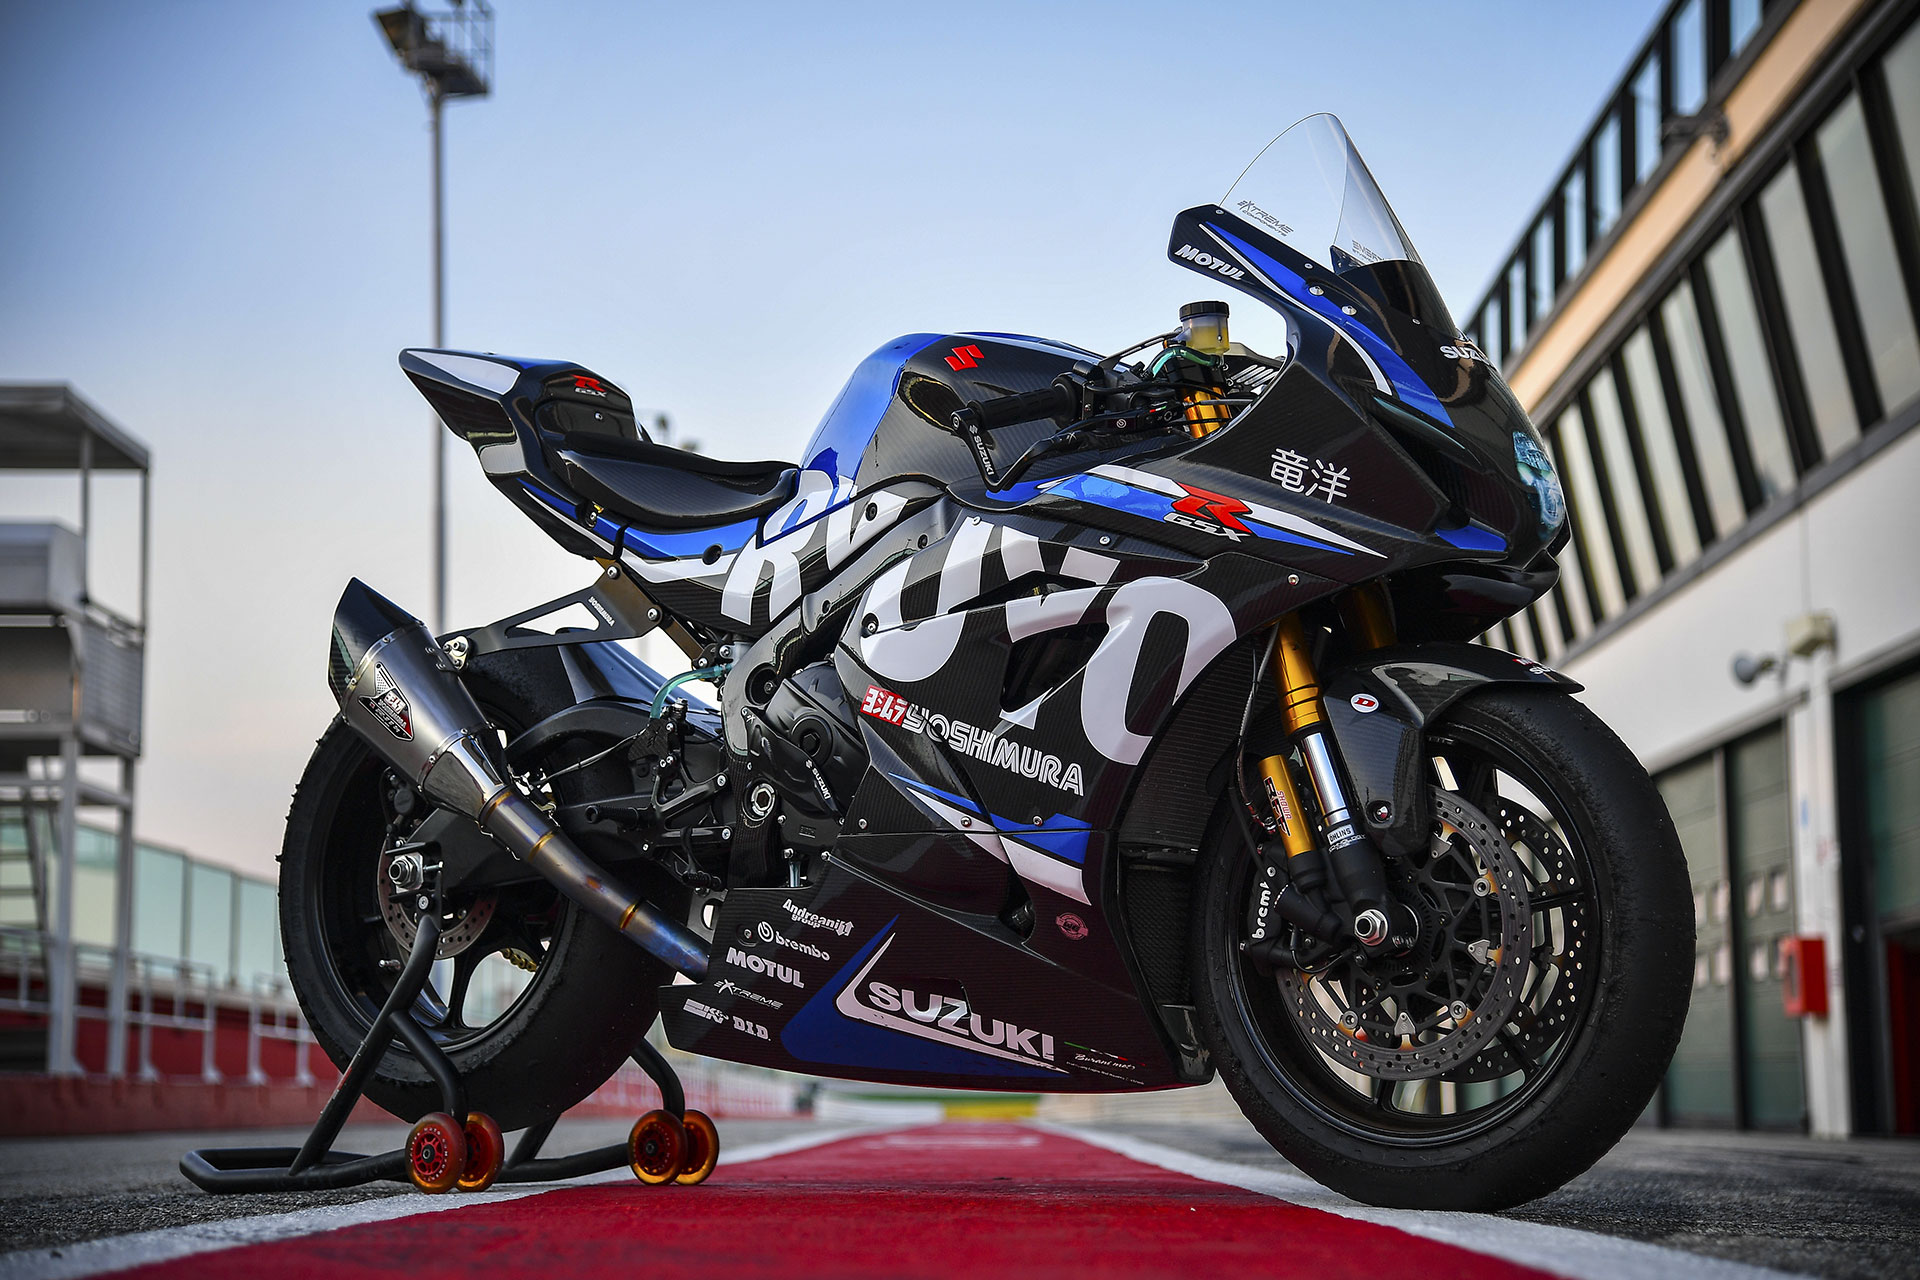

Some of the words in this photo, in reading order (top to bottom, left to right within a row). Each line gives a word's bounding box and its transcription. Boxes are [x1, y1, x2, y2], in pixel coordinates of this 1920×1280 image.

[1174, 244, 1245, 280] MOTUL
[1440, 345, 1485, 362] SUZ
[974, 435, 995, 475] SUZUKI
[1271, 448, 1350, 504] 竜洋
[1163, 512, 1251, 543] GSX
[901, 702, 1084, 797] YOSHIMURA
[811, 767, 832, 800] SUZUKI
[1277, 790, 1293, 820] SHOWA
[783, 899, 841, 929] Andreani
[791, 914, 820, 929] group
[775, 931, 831, 962] brembo
[726, 946, 805, 989] MOTUL
[868, 981, 1055, 1062] SUZUKI
